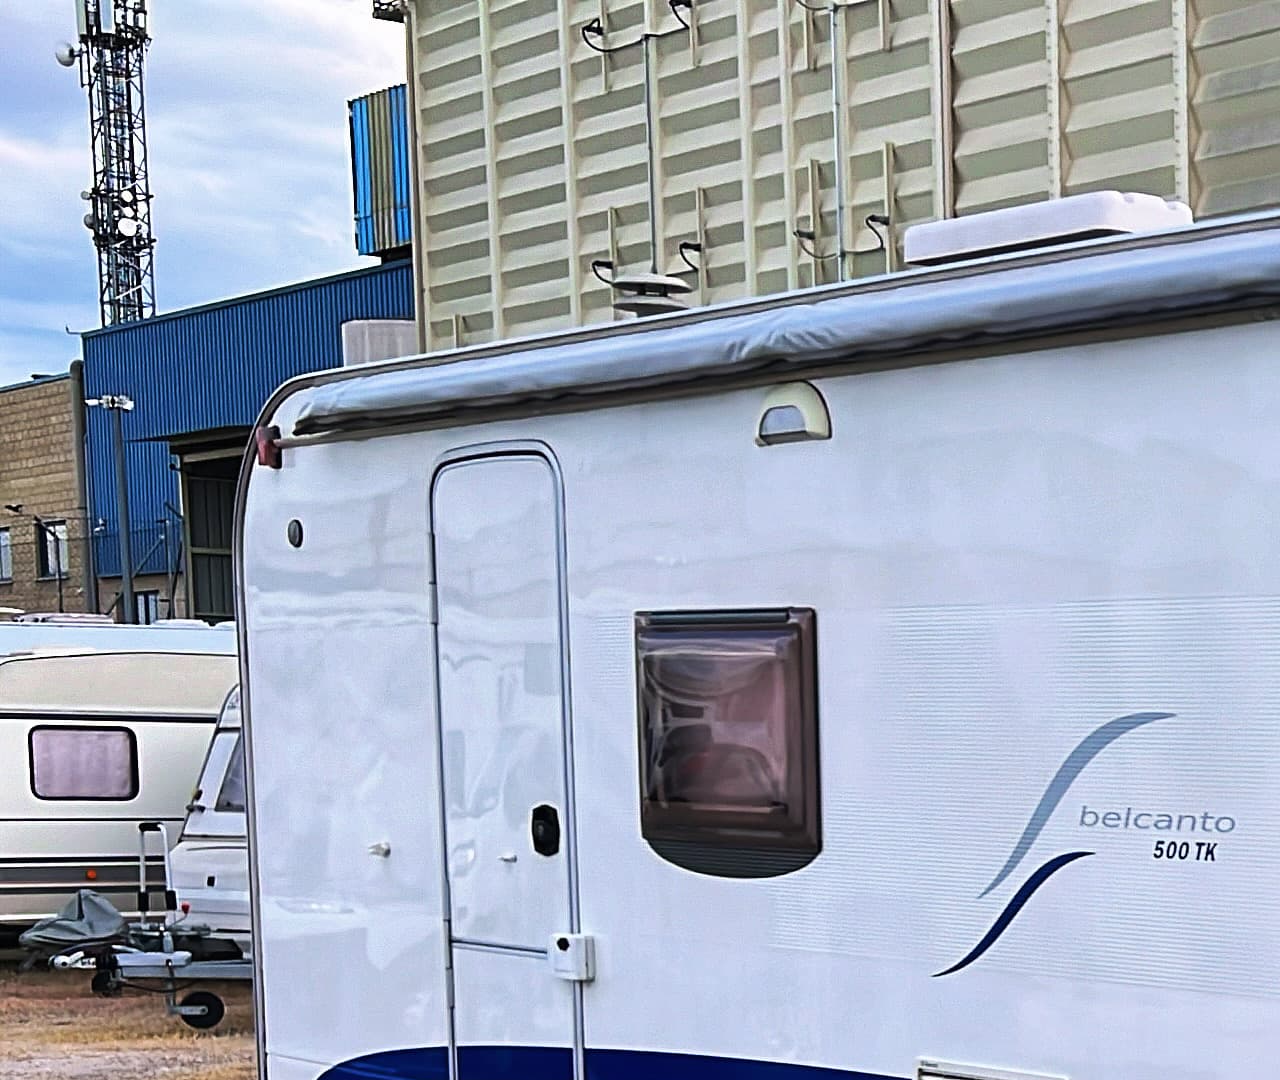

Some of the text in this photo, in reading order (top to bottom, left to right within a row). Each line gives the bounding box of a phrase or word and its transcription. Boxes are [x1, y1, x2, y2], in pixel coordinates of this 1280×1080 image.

[1079, 805, 1236, 833] belcanto
[1152, 840, 1218, 861] 500 TK
